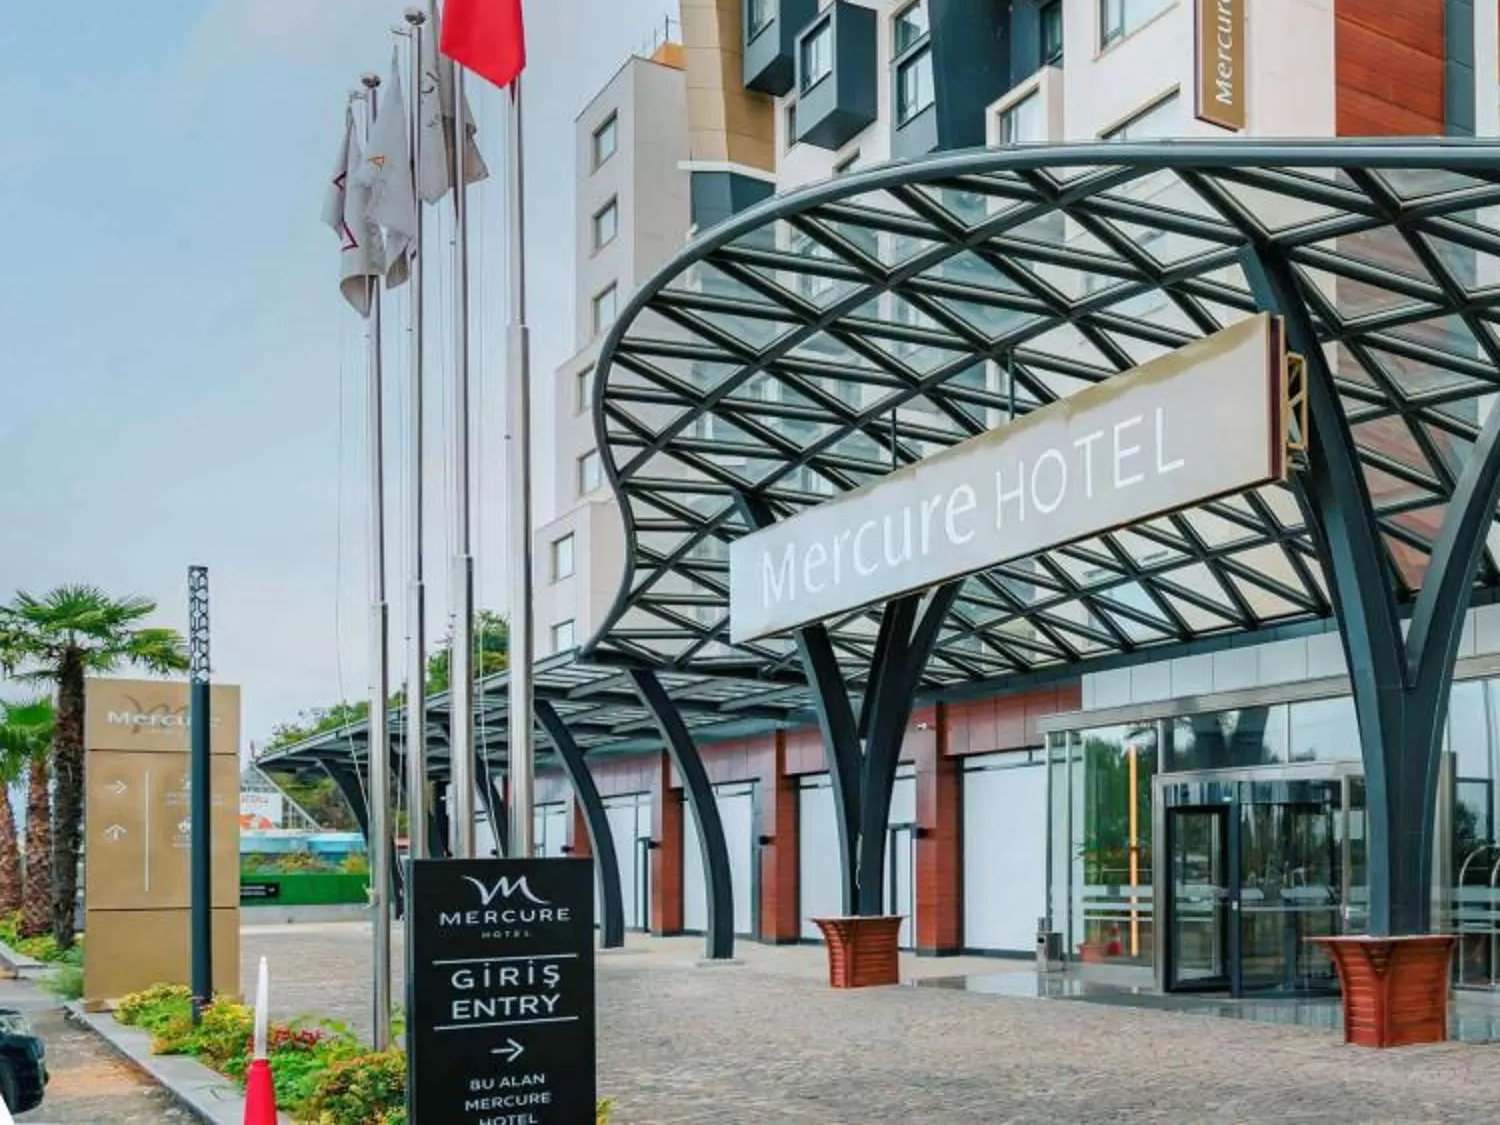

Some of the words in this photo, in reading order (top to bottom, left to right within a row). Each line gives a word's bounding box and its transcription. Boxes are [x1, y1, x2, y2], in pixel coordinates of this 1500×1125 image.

[760, 483, 978, 610] Mercure
[995, 406, 1185, 531] HOTEL
[439, 907, 572, 926] MERCURE
[481, 930, 532, 940] HOTEL
[451, 960, 561, 989] GİRİŞ
[452, 993, 561, 1020] ENTRY
[469, 1078, 495, 1091] BU
[499, 1073, 546, 1089] ALAN
[464, 1092, 552, 1112] MERCURE
[479, 1112, 538, 1125] HOTEL
